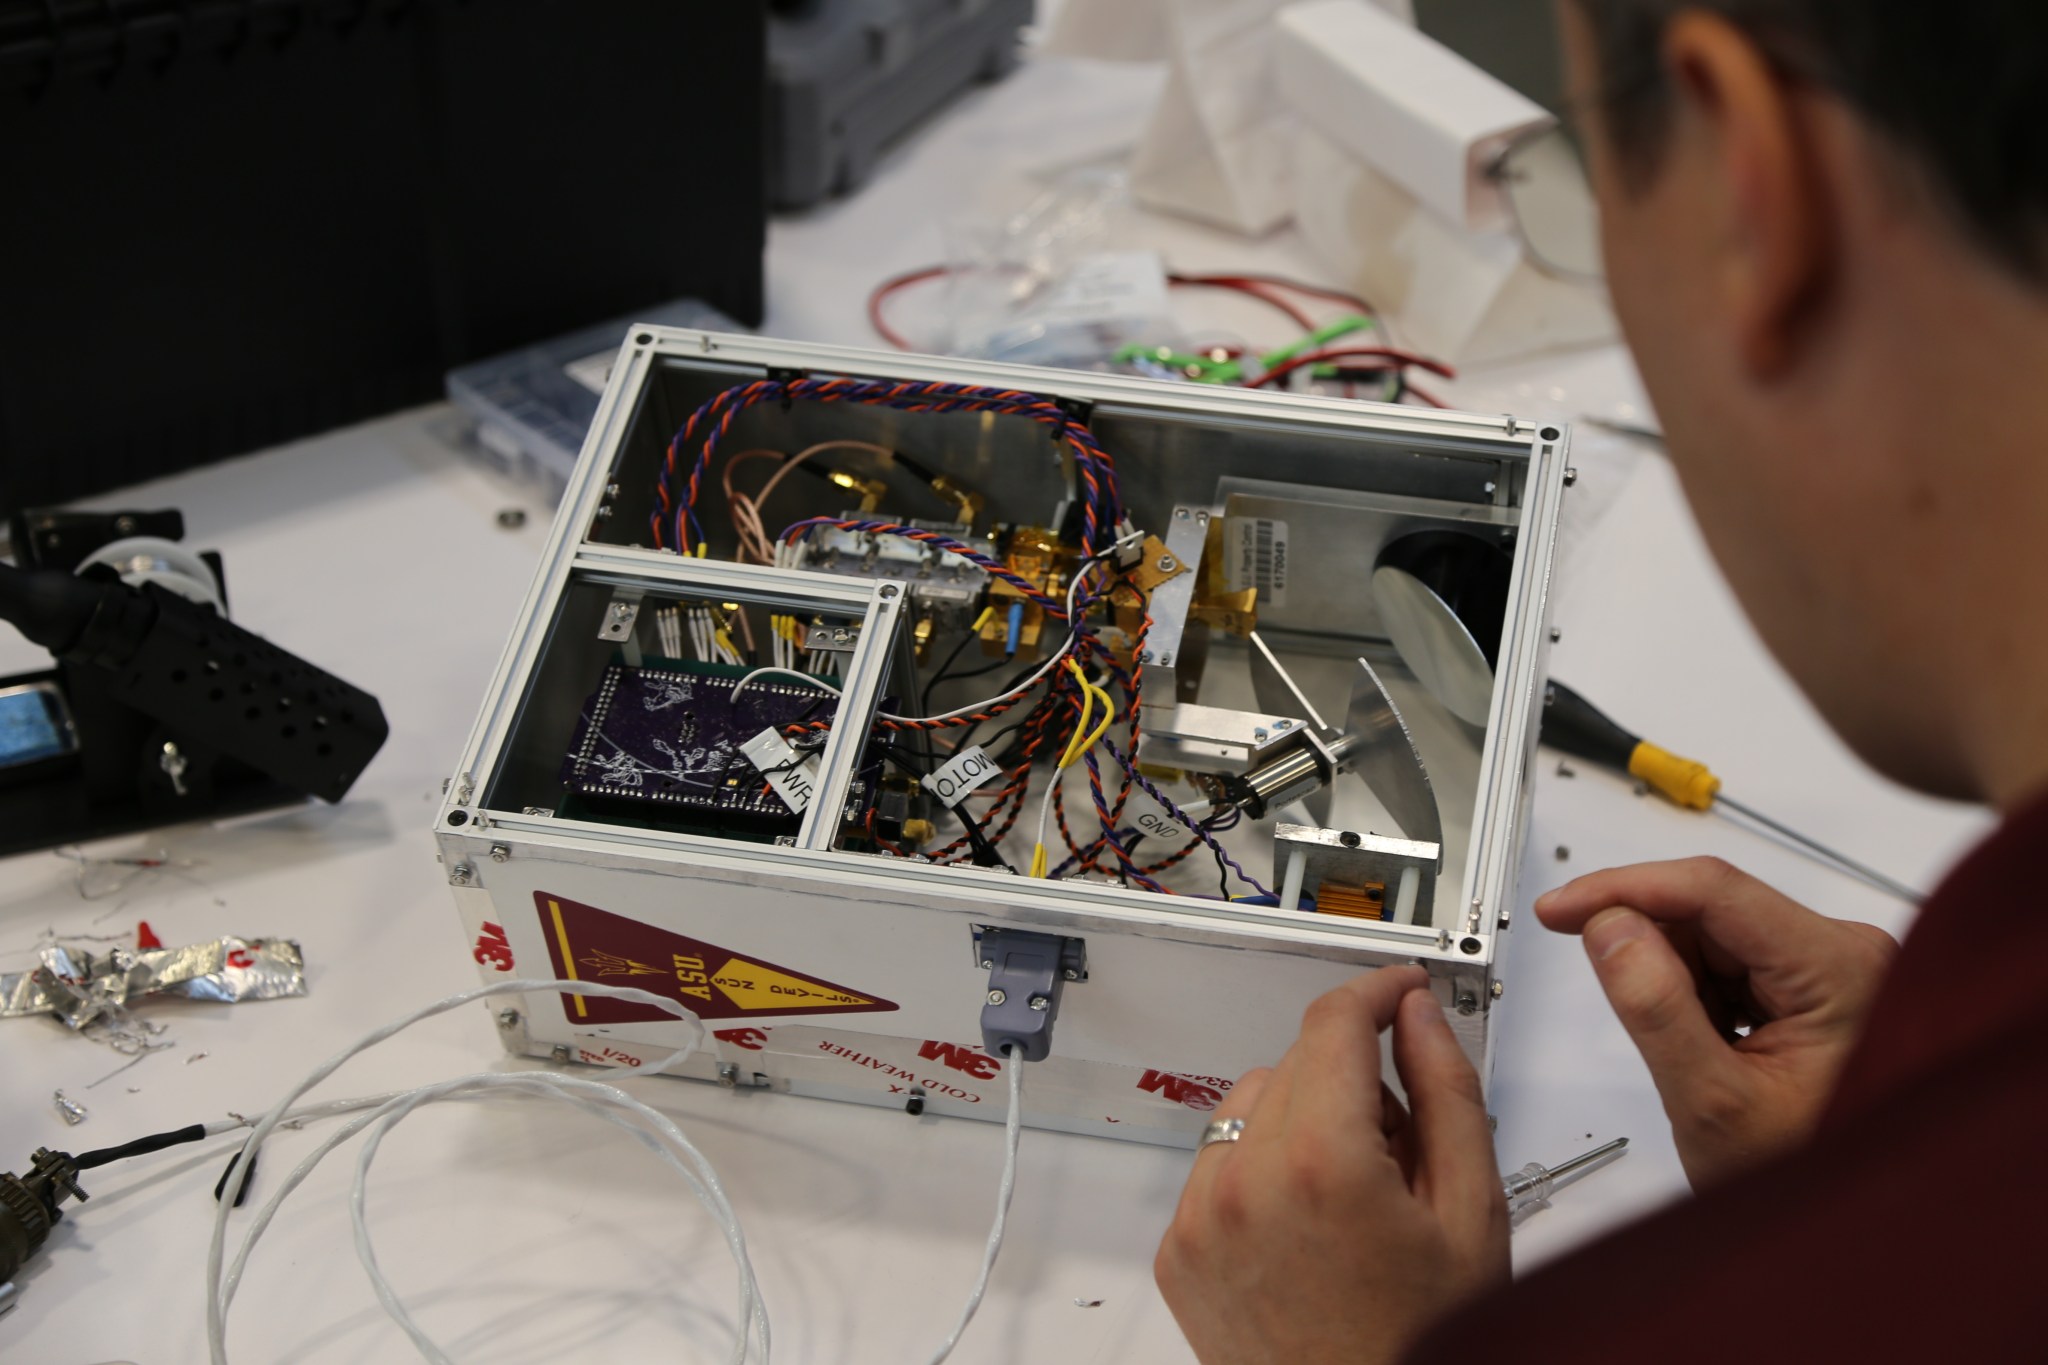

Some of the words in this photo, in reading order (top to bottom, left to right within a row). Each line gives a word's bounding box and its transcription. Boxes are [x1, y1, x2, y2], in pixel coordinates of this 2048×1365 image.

[929, 751, 996, 804] MOTO
[1138, 814, 1179, 837] GND
[473, 920, 515, 972] 3M
[672, 953, 712, 1001] ASU
[714, 978, 755, 990] SUN
[769, 985, 852, 1003] DEVILS
[819, 1040, 915, 1082] WEATHER
[917, 1039, 1002, 1081] 3M
[921, 1079, 981, 1103] COLD
[1136, 1068, 1223, 1112] 3M
